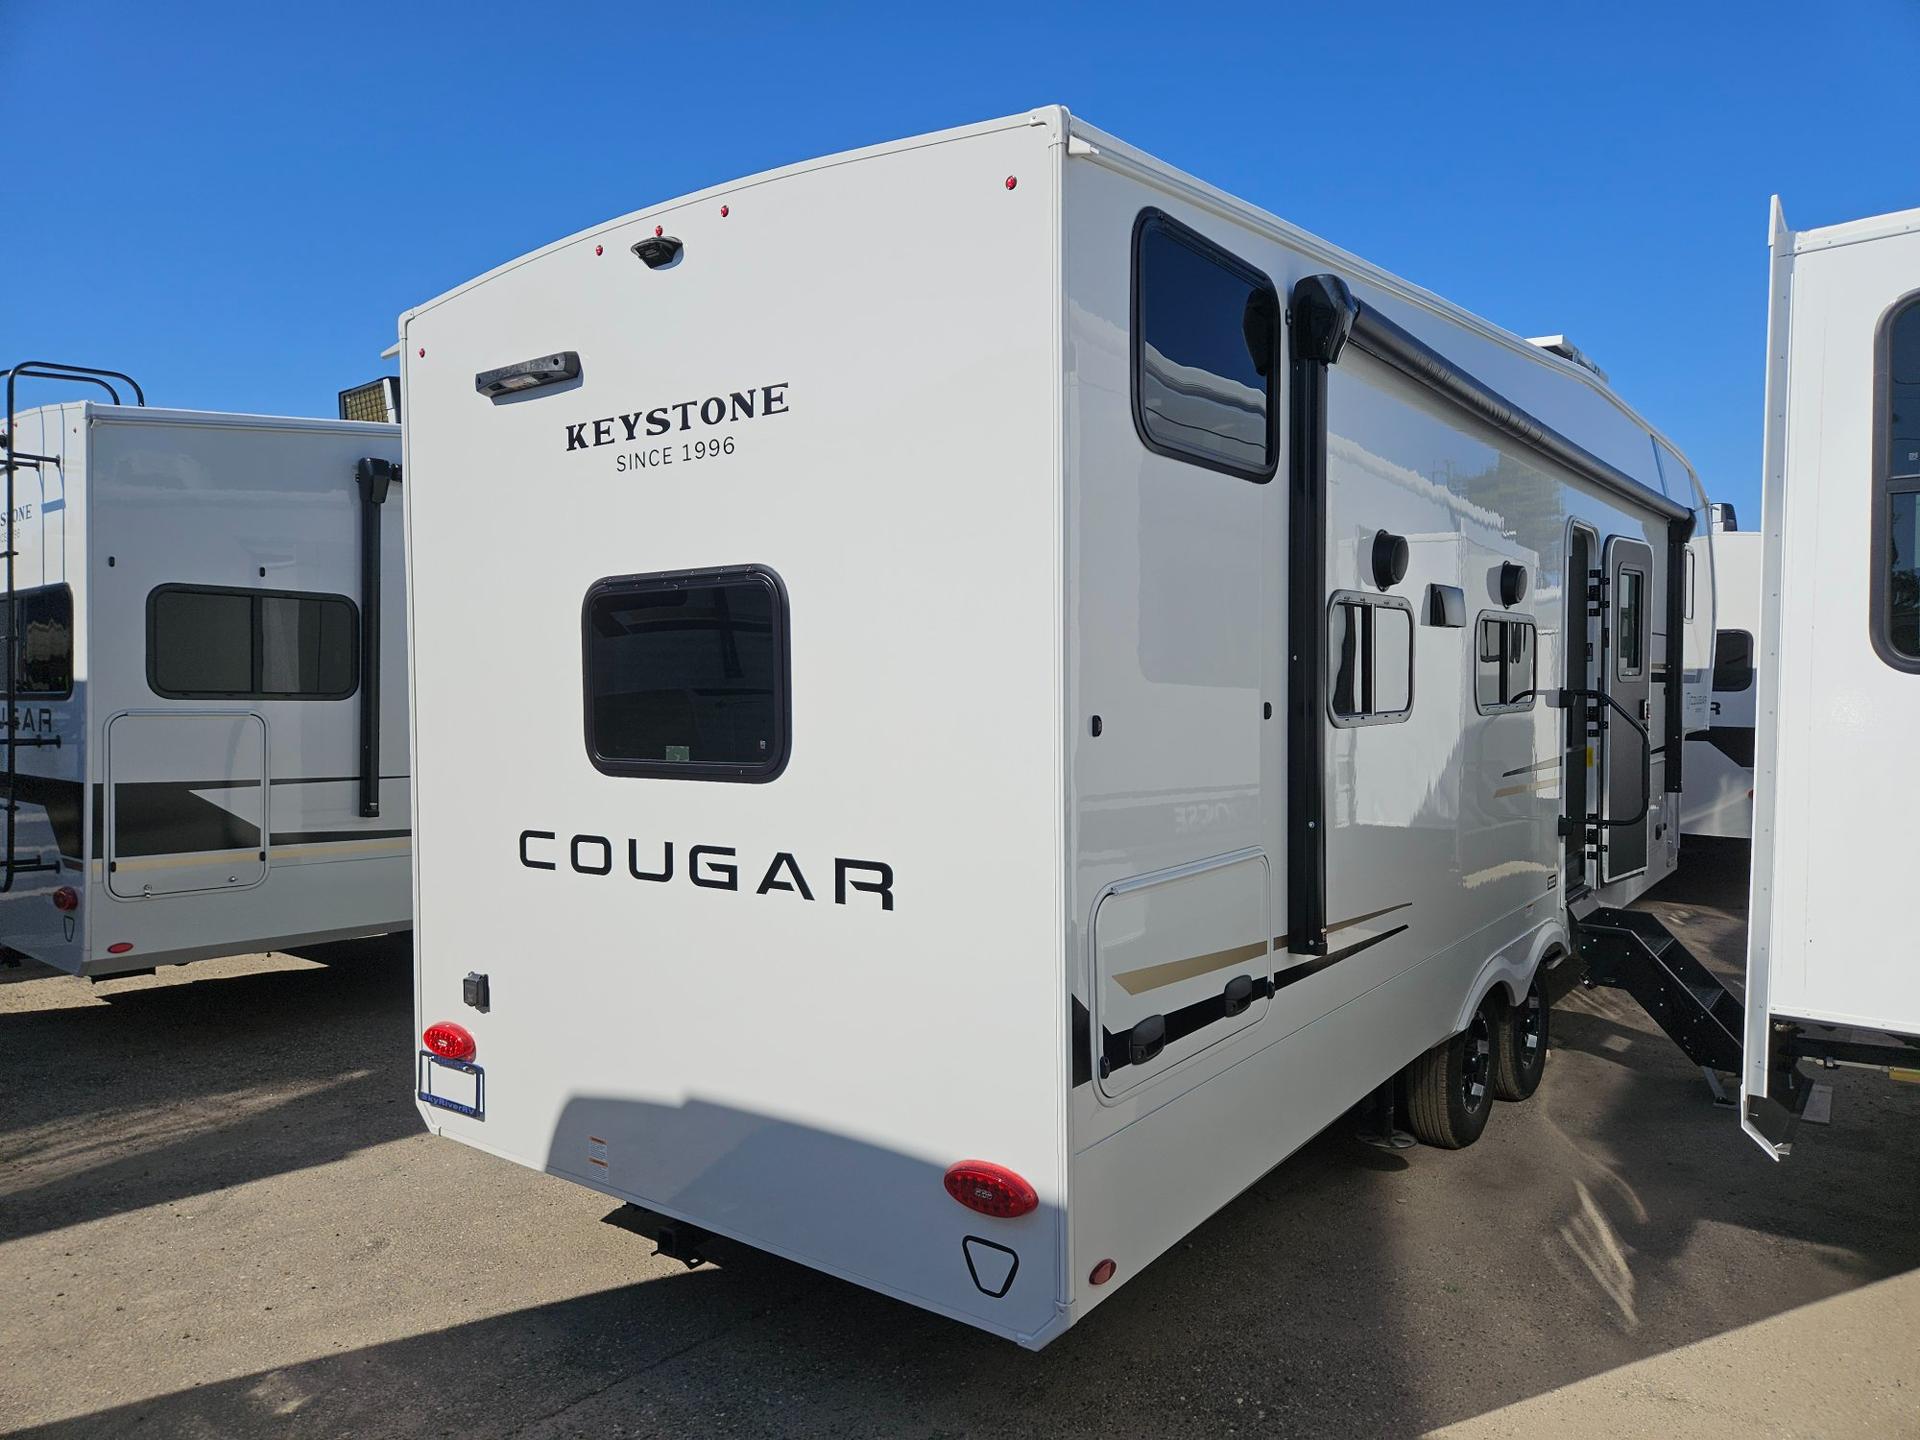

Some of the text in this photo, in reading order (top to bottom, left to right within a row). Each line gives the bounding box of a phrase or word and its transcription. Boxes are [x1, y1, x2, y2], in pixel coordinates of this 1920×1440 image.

[566, 382, 789, 451] KEYSTONE
[616, 436, 735, 472] SINCE 1996
[0, 503, 32, 527] SONE
[519, 829, 894, 911] COUGAR
